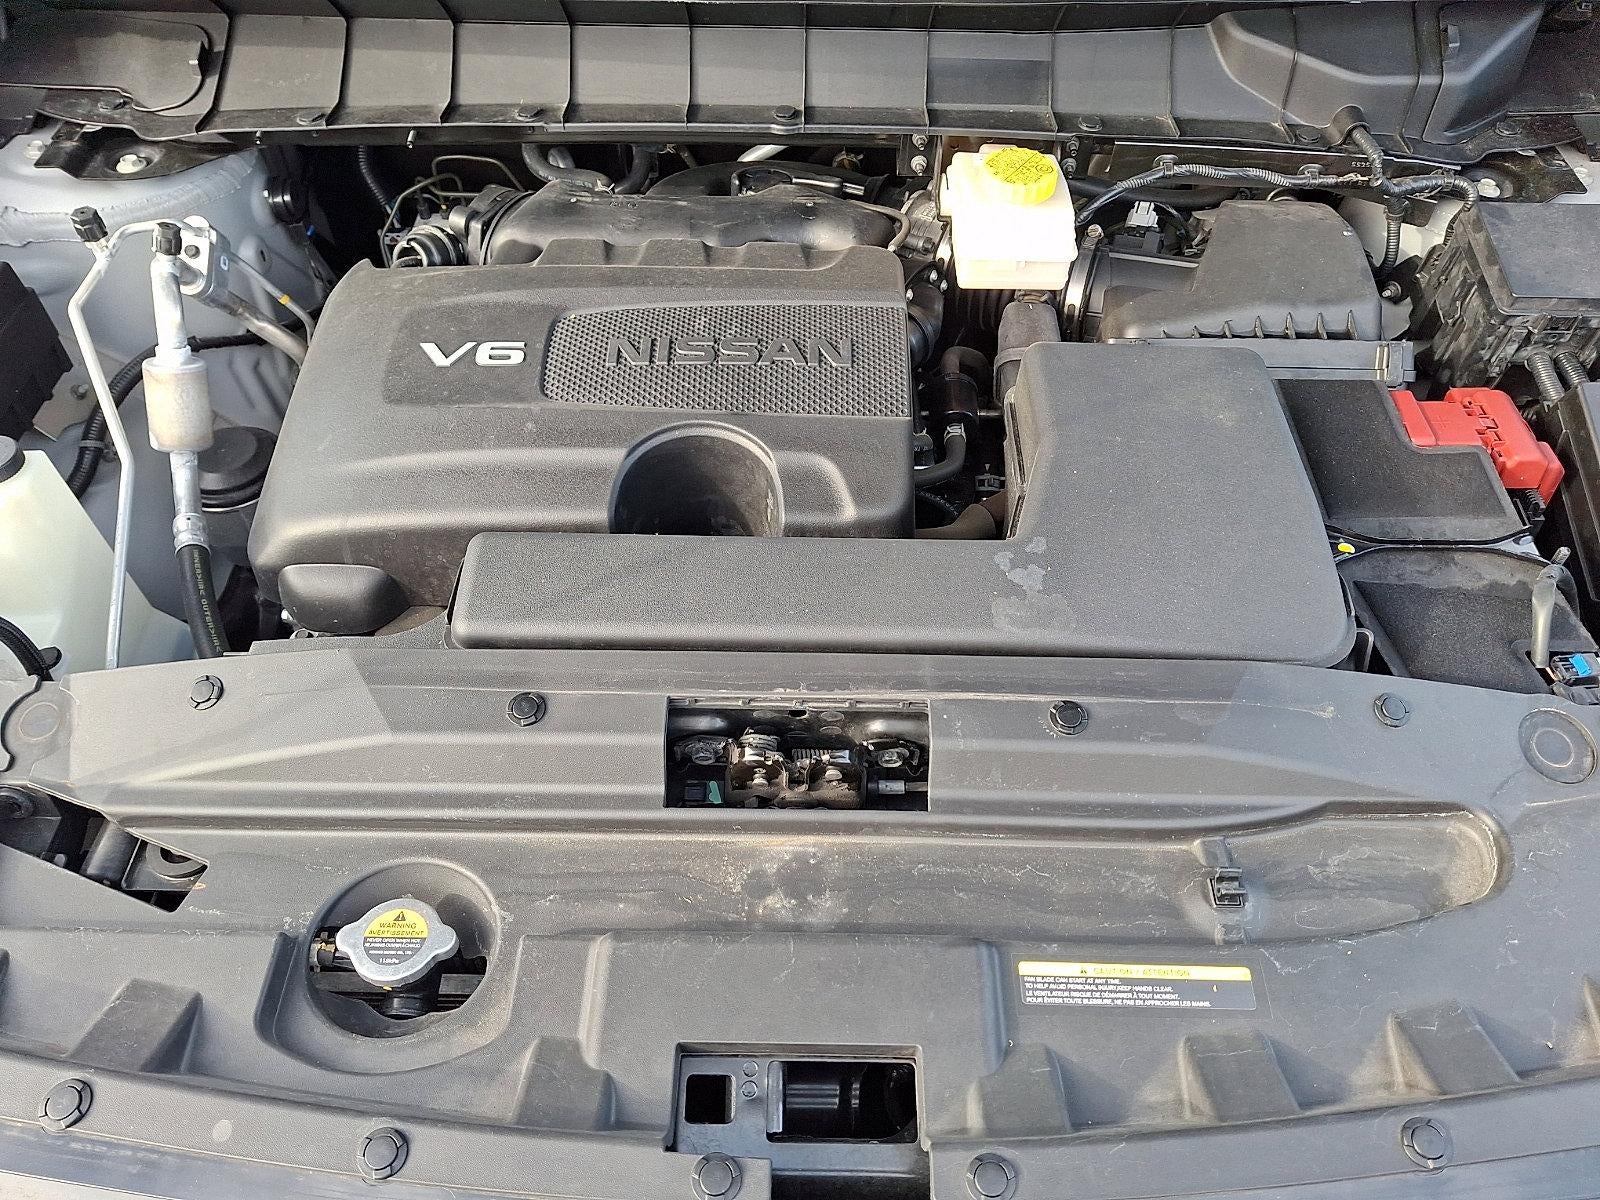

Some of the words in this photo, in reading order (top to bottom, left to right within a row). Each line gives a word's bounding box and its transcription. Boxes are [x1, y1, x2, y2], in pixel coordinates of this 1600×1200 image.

[419, 341, 527, 367] V6
[606, 338, 853, 367] NISSAN
[379, 922, 417, 930] WARNING
[1093, 967, 1133, 976] CAUTION
[1142, 968, 1190, 978] ATTENTION
[1043, 995, 1063, 1003] ÉVITER
[1101, 991, 1132, 999] DÉMARRER
[1133, 991, 1138, 999] À
